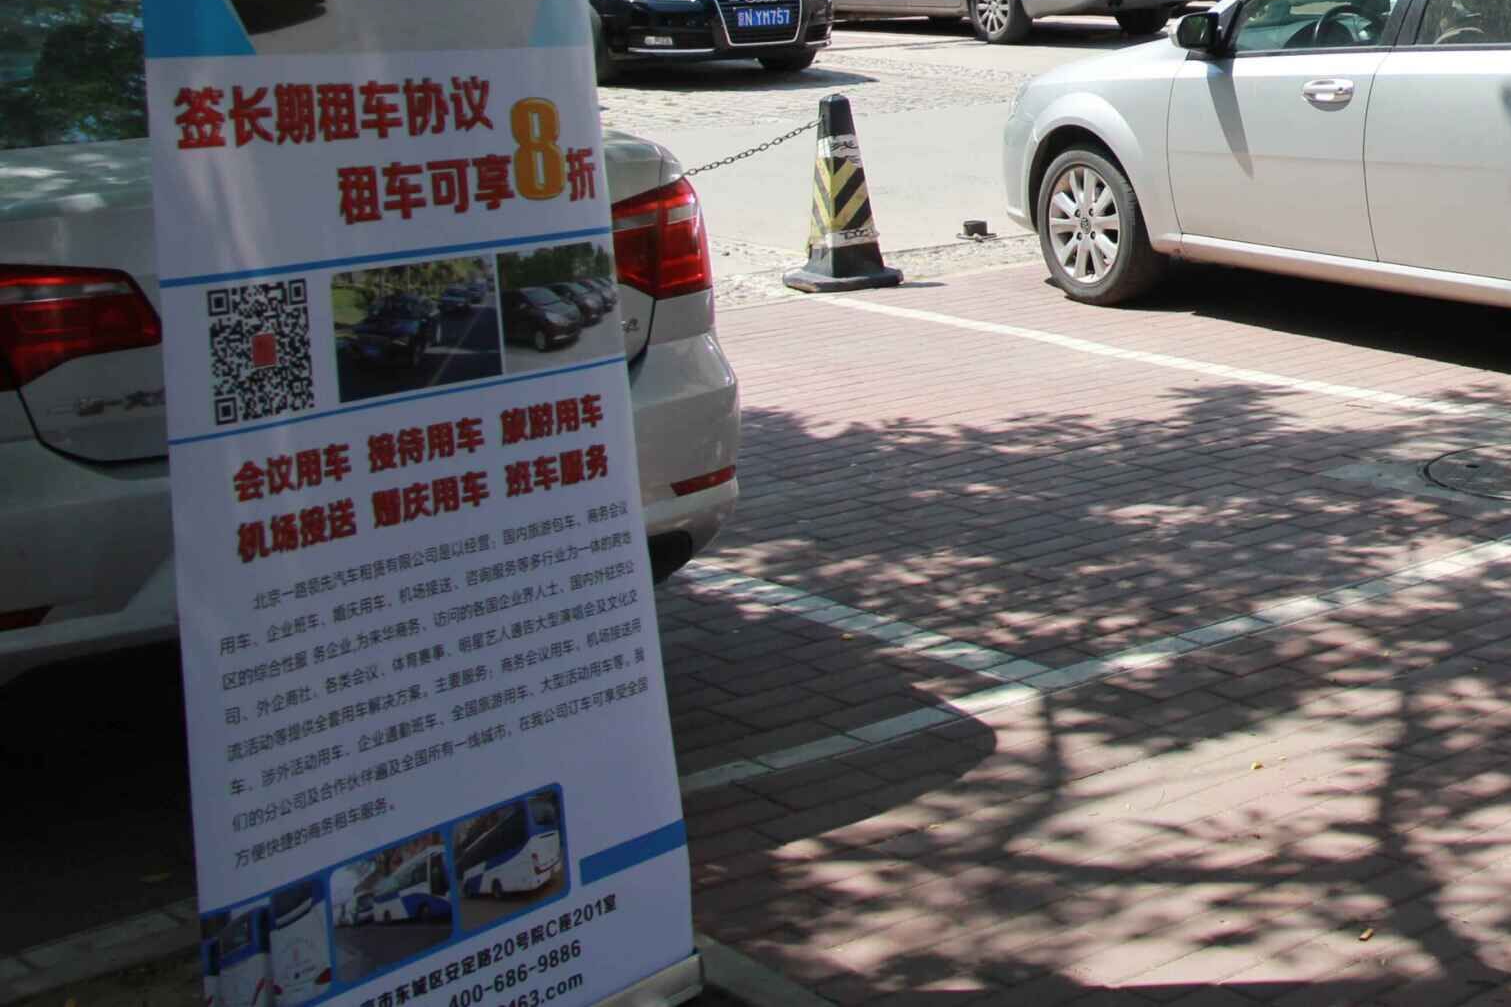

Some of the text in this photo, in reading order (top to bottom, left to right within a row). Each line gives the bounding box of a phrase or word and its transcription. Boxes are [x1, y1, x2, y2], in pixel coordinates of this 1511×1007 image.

[173, 76, 494, 151] 签长期租车协议
[233, 394, 604, 502] 会议用车 接待用车 旅游用车
[237, 444, 610, 563] 机场接送 婚庆用车 班车服务
[448, 940, 582, 1007] 400-686-9886
